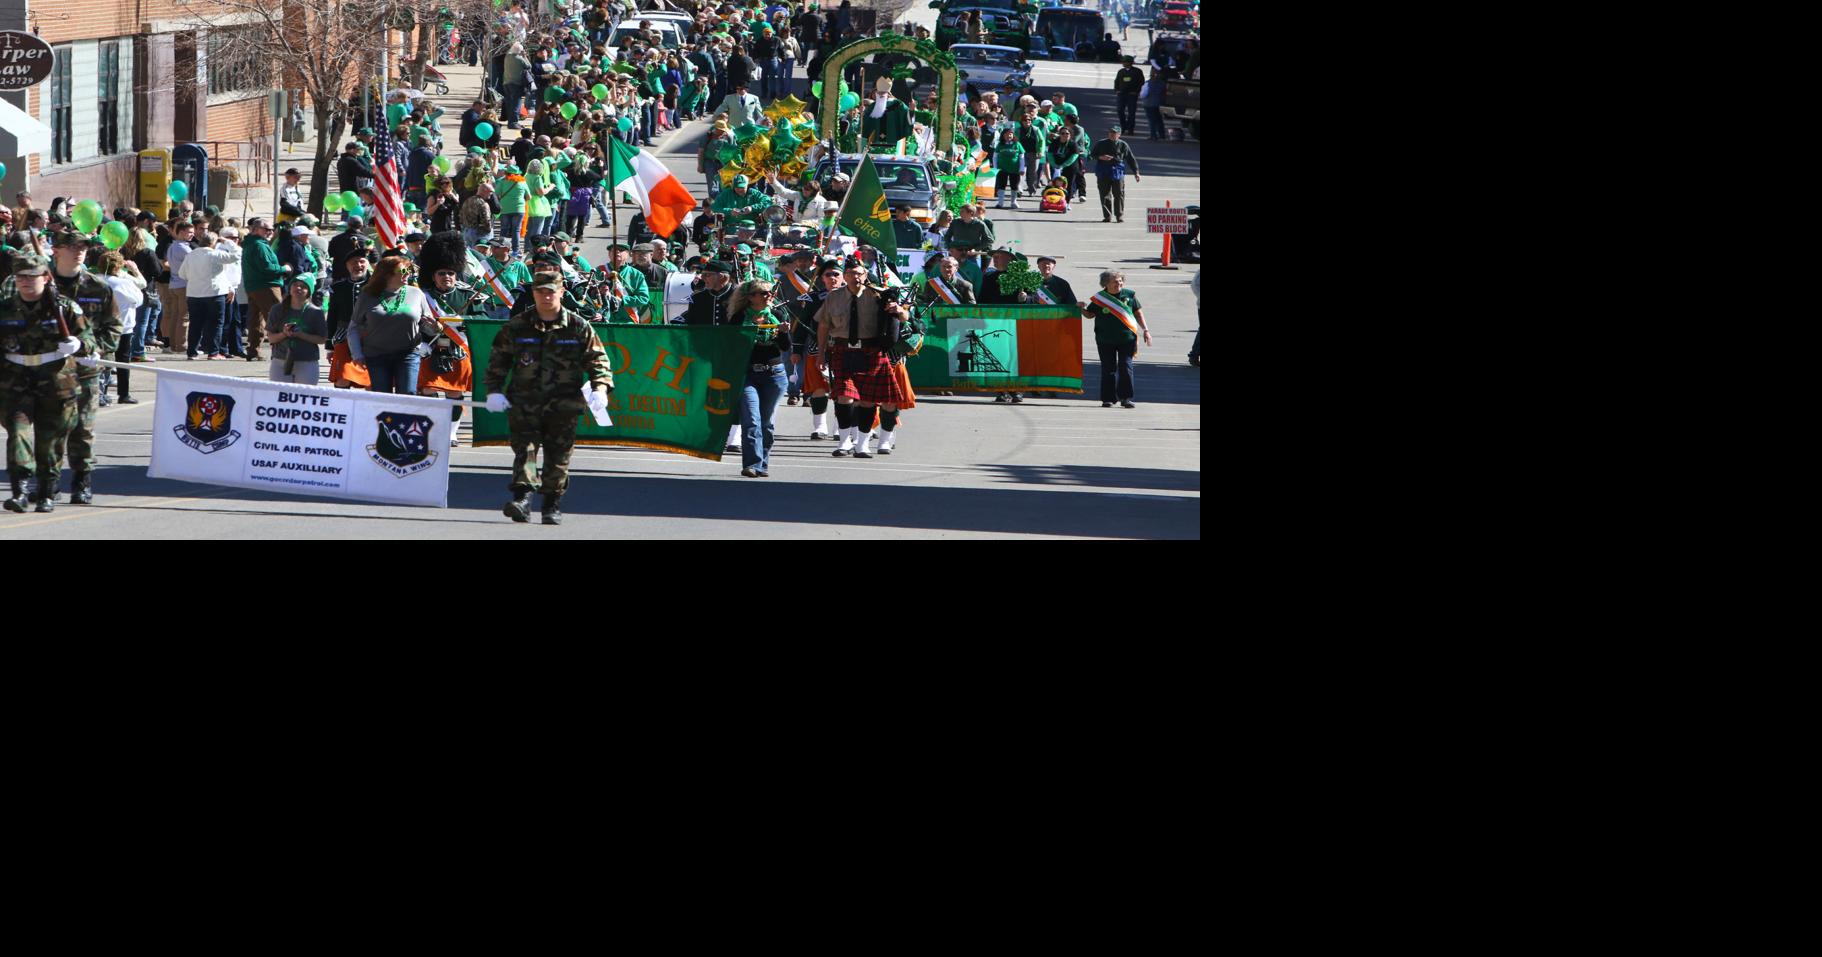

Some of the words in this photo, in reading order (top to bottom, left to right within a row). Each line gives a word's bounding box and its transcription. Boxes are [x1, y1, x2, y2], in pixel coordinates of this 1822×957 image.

[0, 65, 31, 75] aw
[1147, 215, 1157, 224] NO
[1158, 215, 1187, 224] PARKING
[1148, 225, 1164, 233] THIS
[1165, 225, 1187, 233] BLOCK
[277, 391, 330, 407] BUTTE
[628, 394, 687, 417] DRUM
[256, 405, 347, 425] COMPOSITE
[255, 420, 344, 440] SQUADRON
[254, 441, 280, 451] CIVIL
[283, 445, 301, 453] AIR
[304, 447, 343, 457] PATROL
[251, 459, 278, 469] USAF
[280, 462, 343, 475] AUXILLIARY
[372, 454, 408, 475] MONTANA
[410, 460, 431, 471] WING
